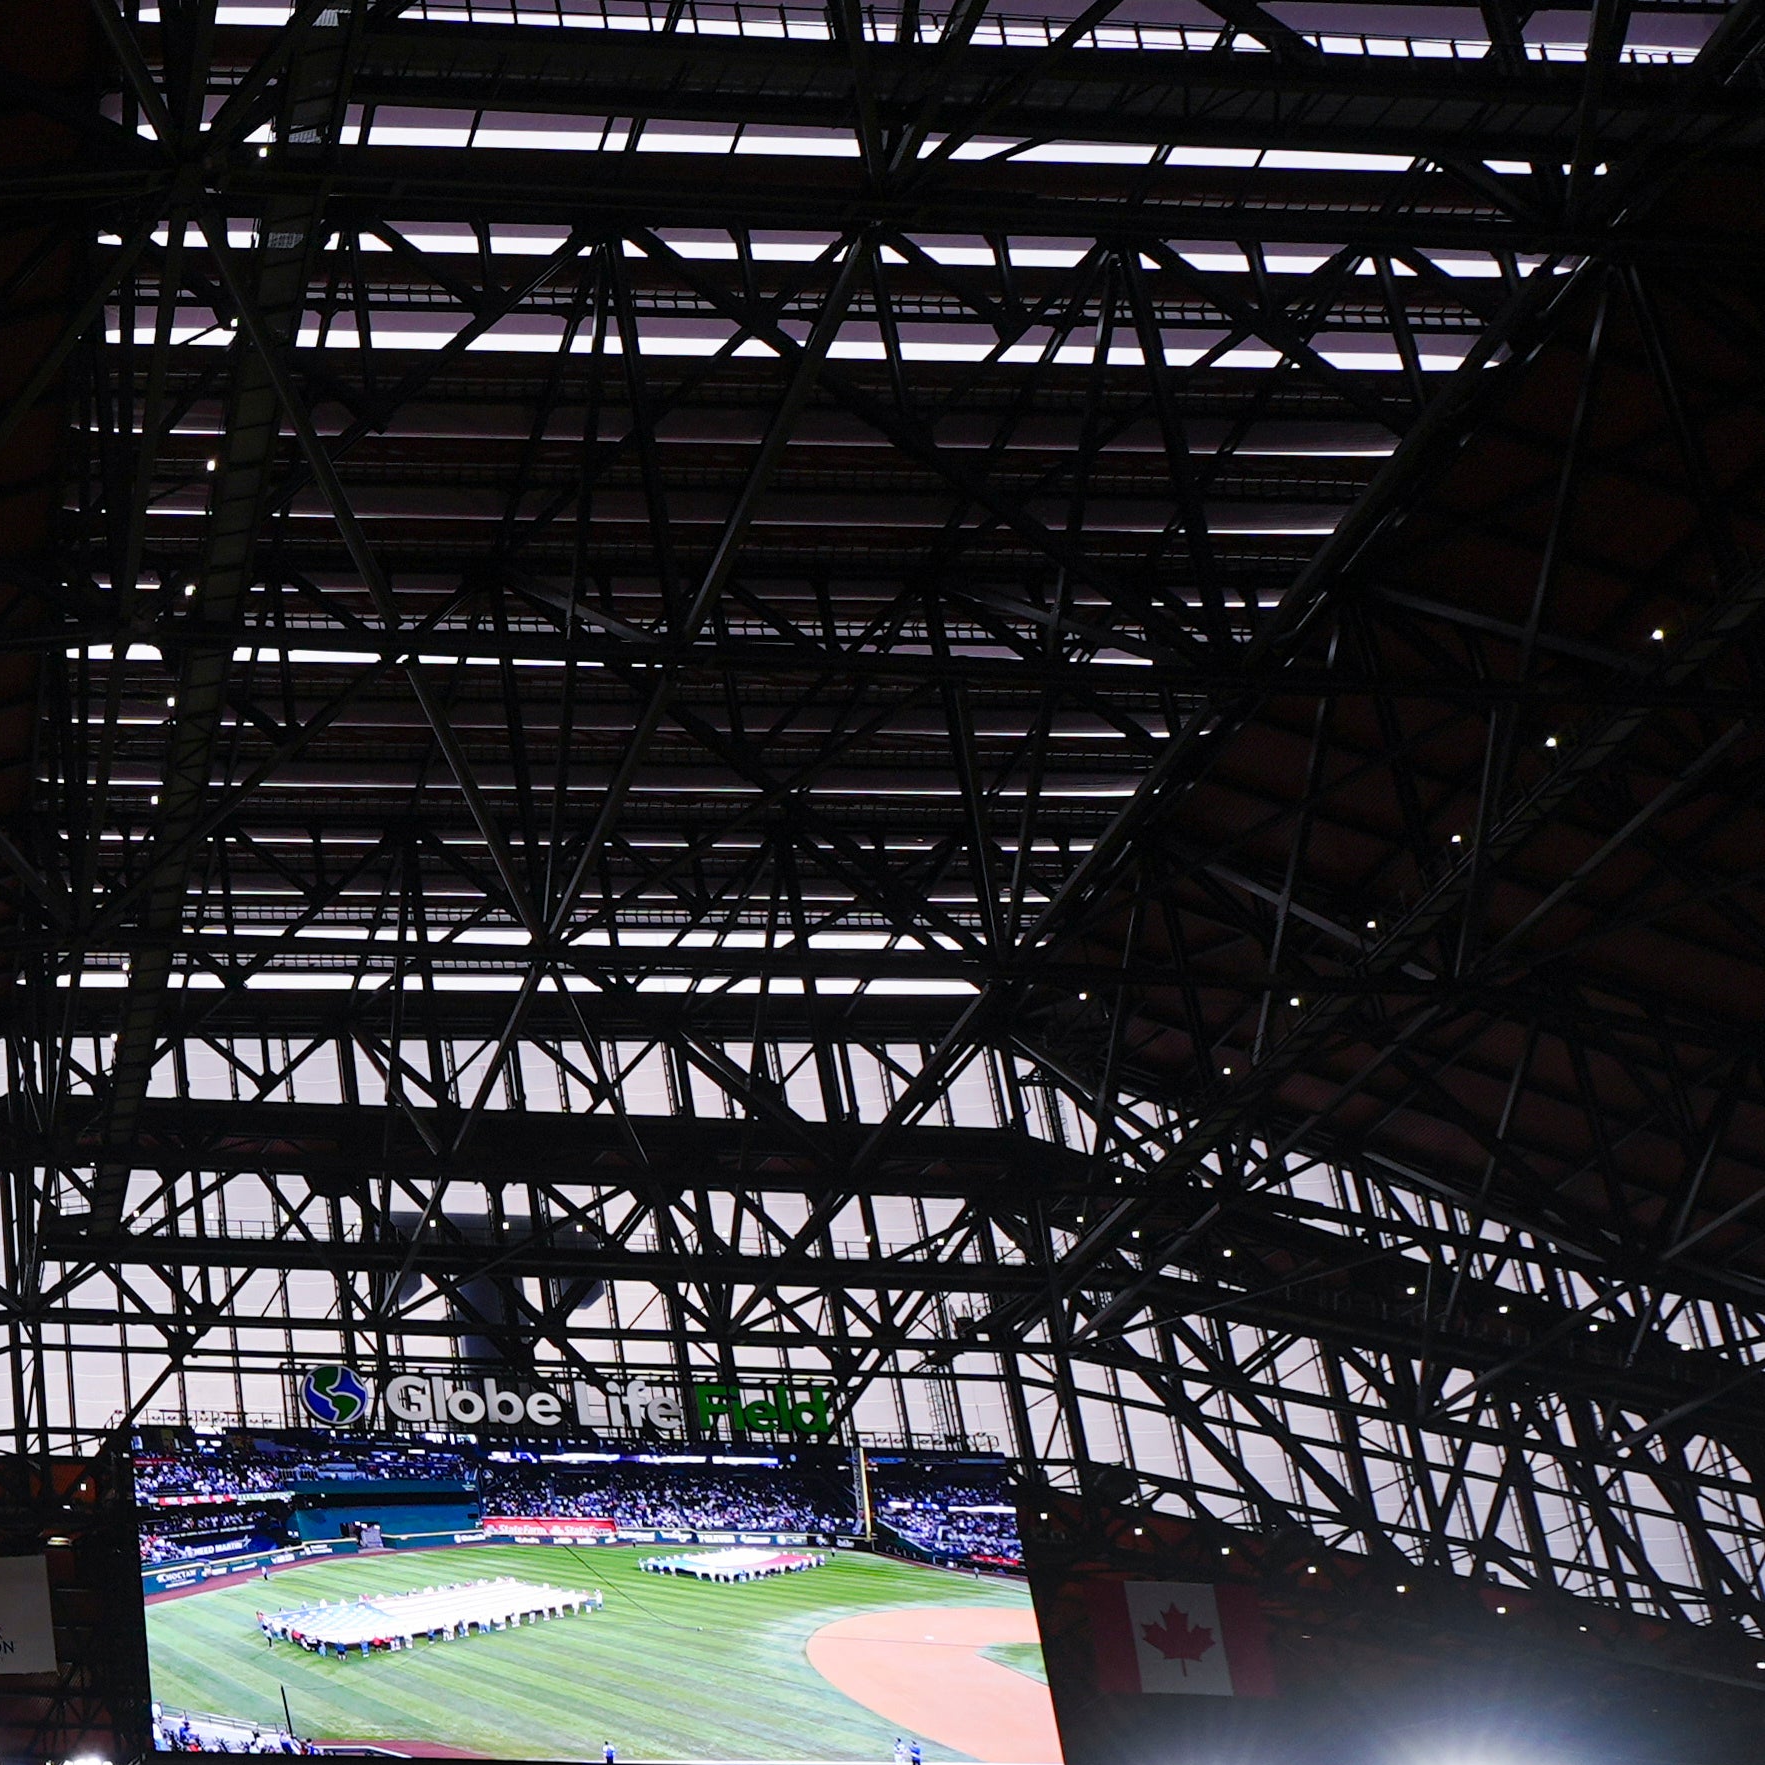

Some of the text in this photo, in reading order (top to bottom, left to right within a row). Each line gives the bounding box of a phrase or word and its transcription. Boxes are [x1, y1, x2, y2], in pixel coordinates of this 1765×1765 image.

[386, 1375, 834, 1434] Globe Life Field
